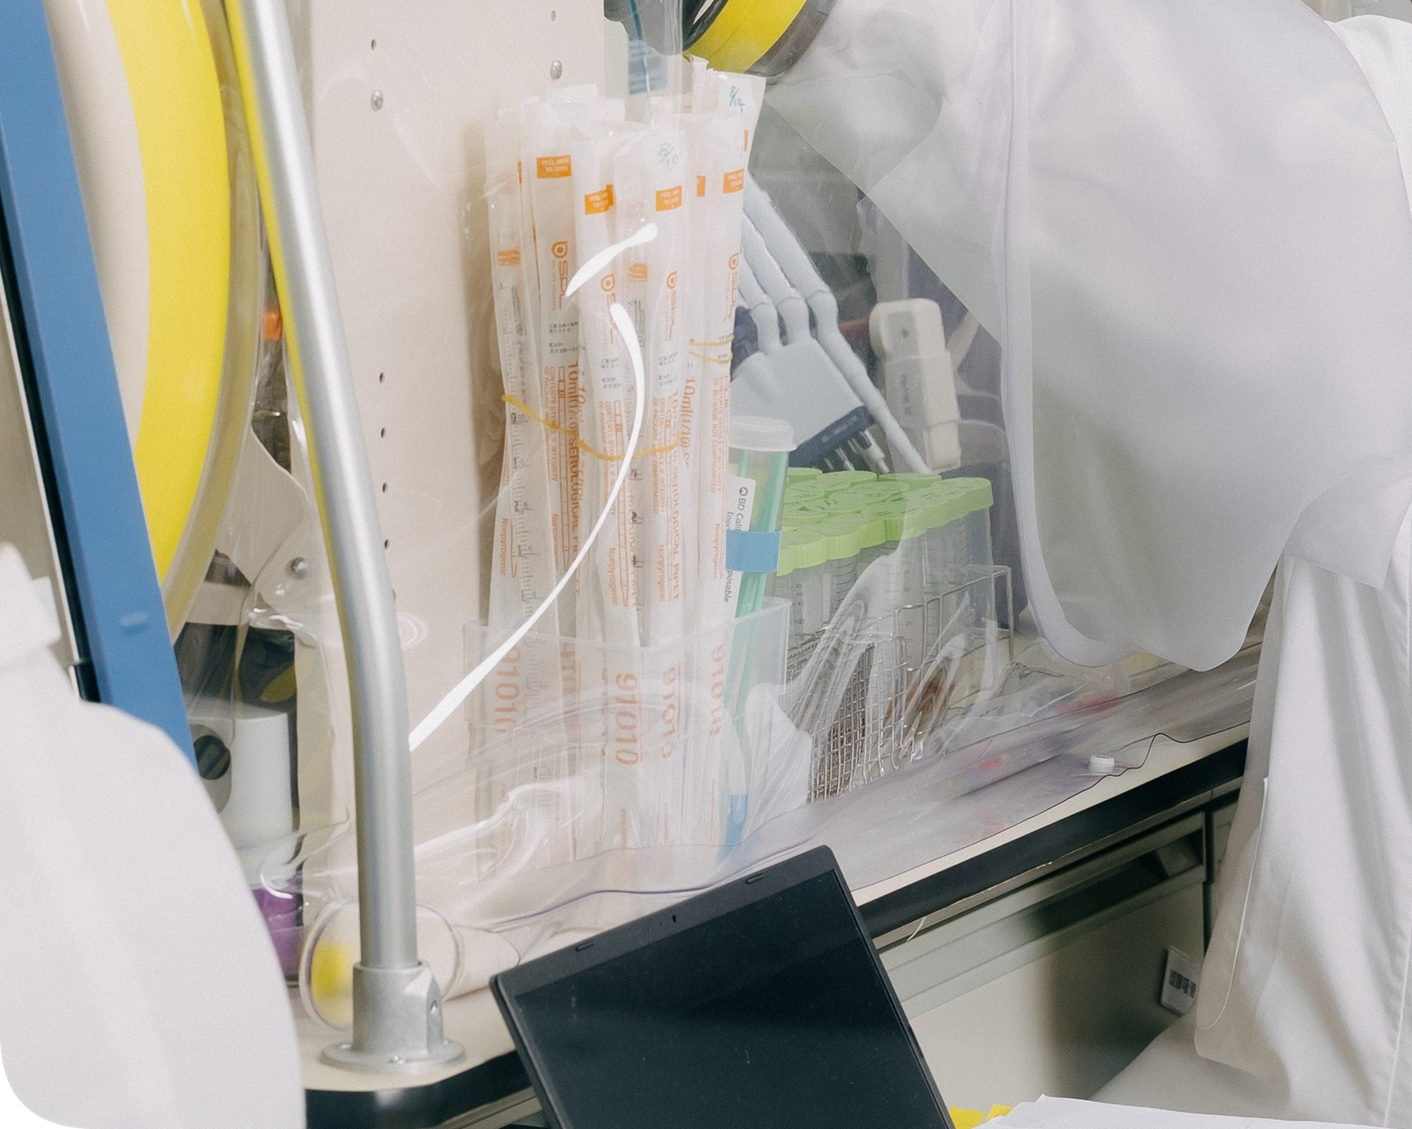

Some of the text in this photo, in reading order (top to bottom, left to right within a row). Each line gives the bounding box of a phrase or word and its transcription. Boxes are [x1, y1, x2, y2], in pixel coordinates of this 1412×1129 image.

[737, 497, 748, 511] BD
[499, 517, 510, 578] Nonpyrogenic
[608, 547, 618, 606] Nonpyrogenic
[656, 544, 667, 603] Nonpyrogenic
[614, 672, 640, 766] 91010
[709, 644, 724, 737] 91010
